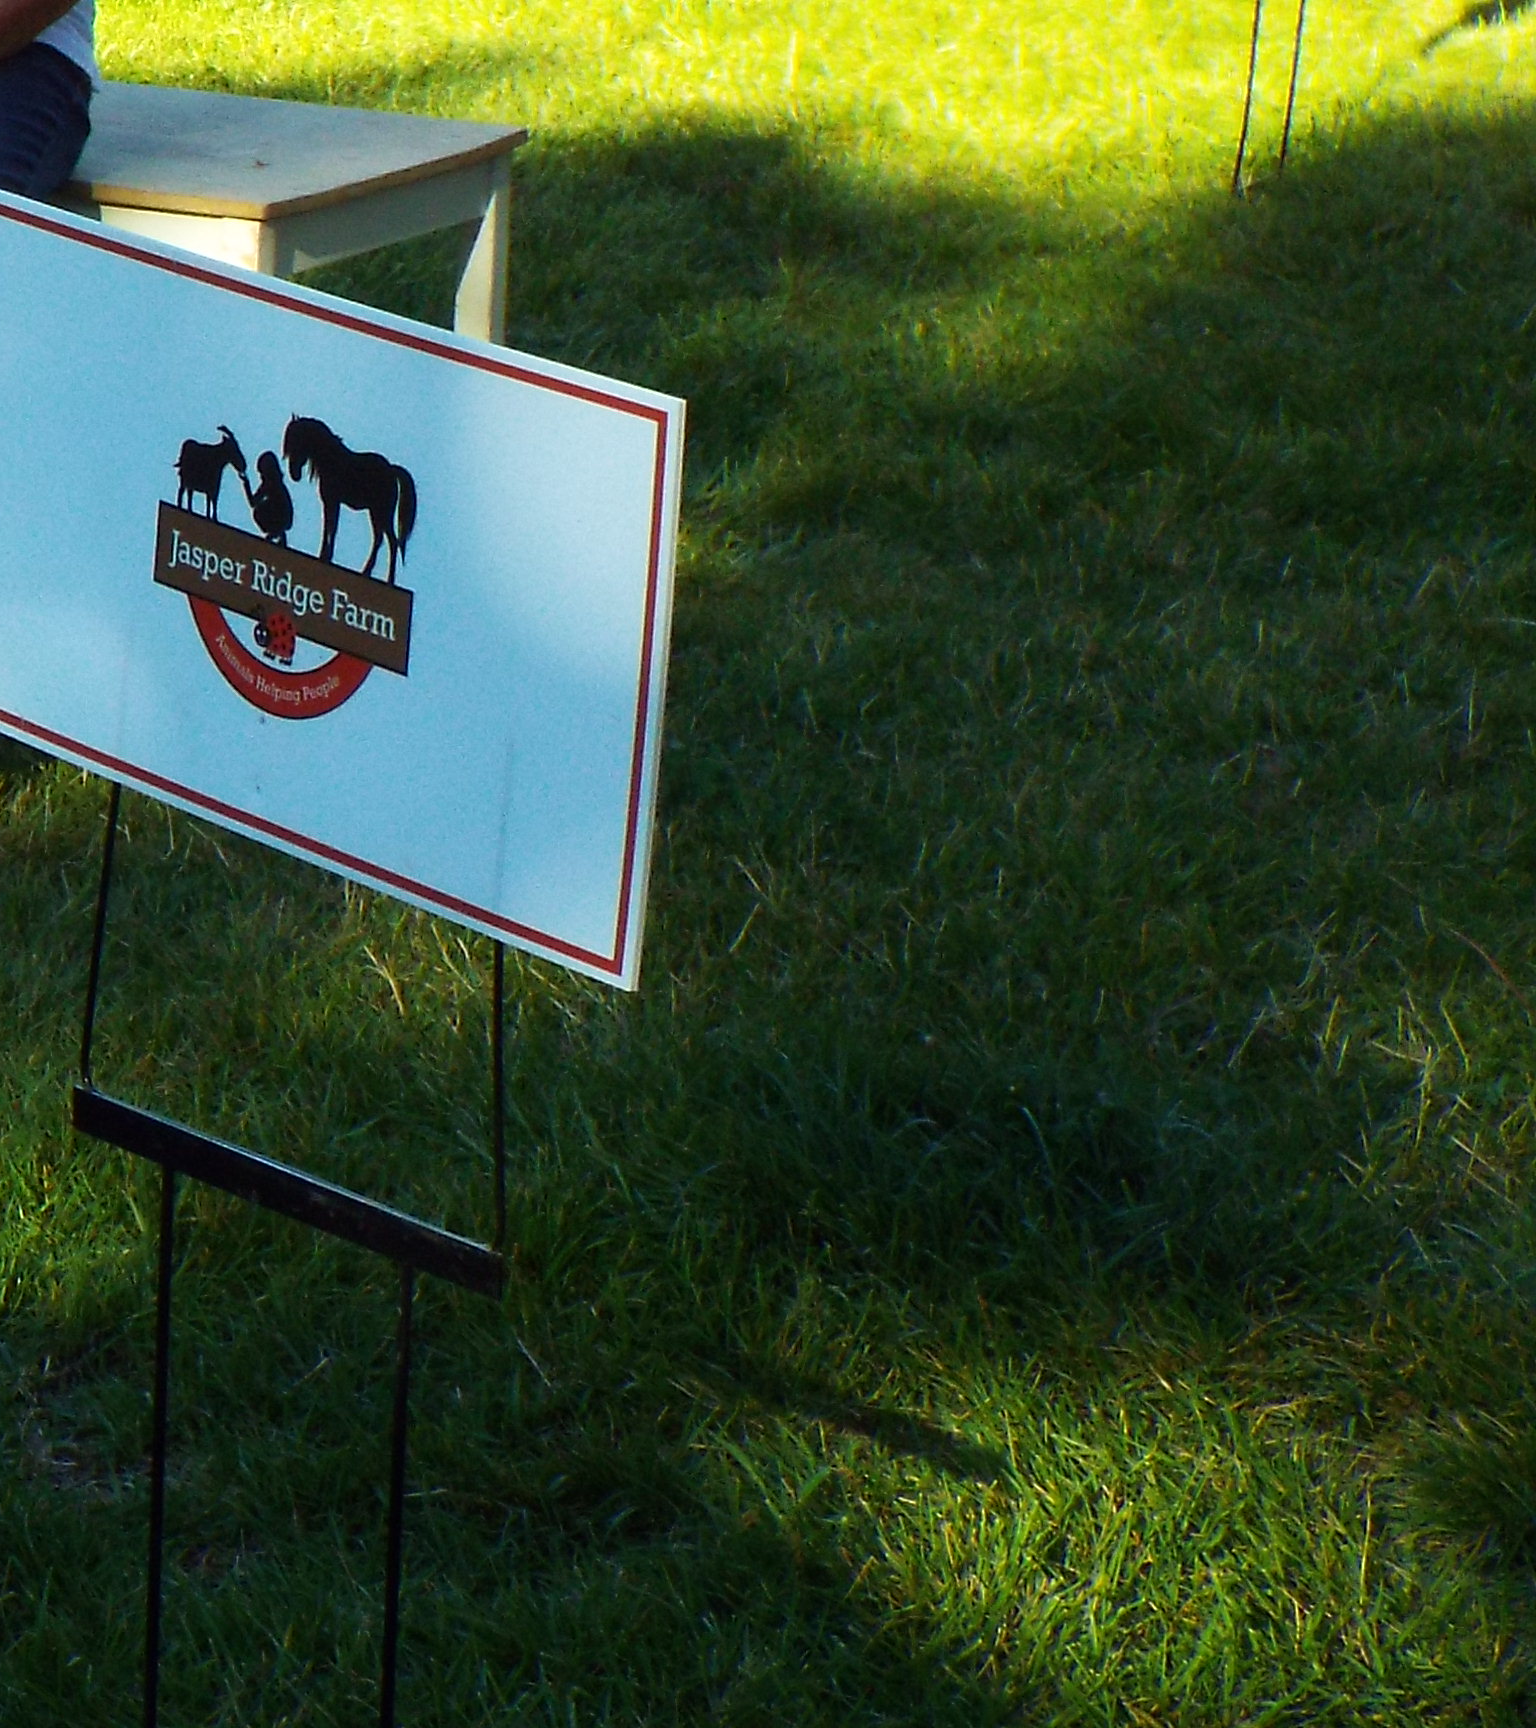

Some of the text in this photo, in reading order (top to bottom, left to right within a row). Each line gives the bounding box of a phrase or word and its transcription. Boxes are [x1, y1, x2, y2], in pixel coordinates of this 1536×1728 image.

[167, 528, 396, 642] Jasper Ridge Farm
[255, 674, 302, 706] Helping
[301, 675, 341, 701] People
